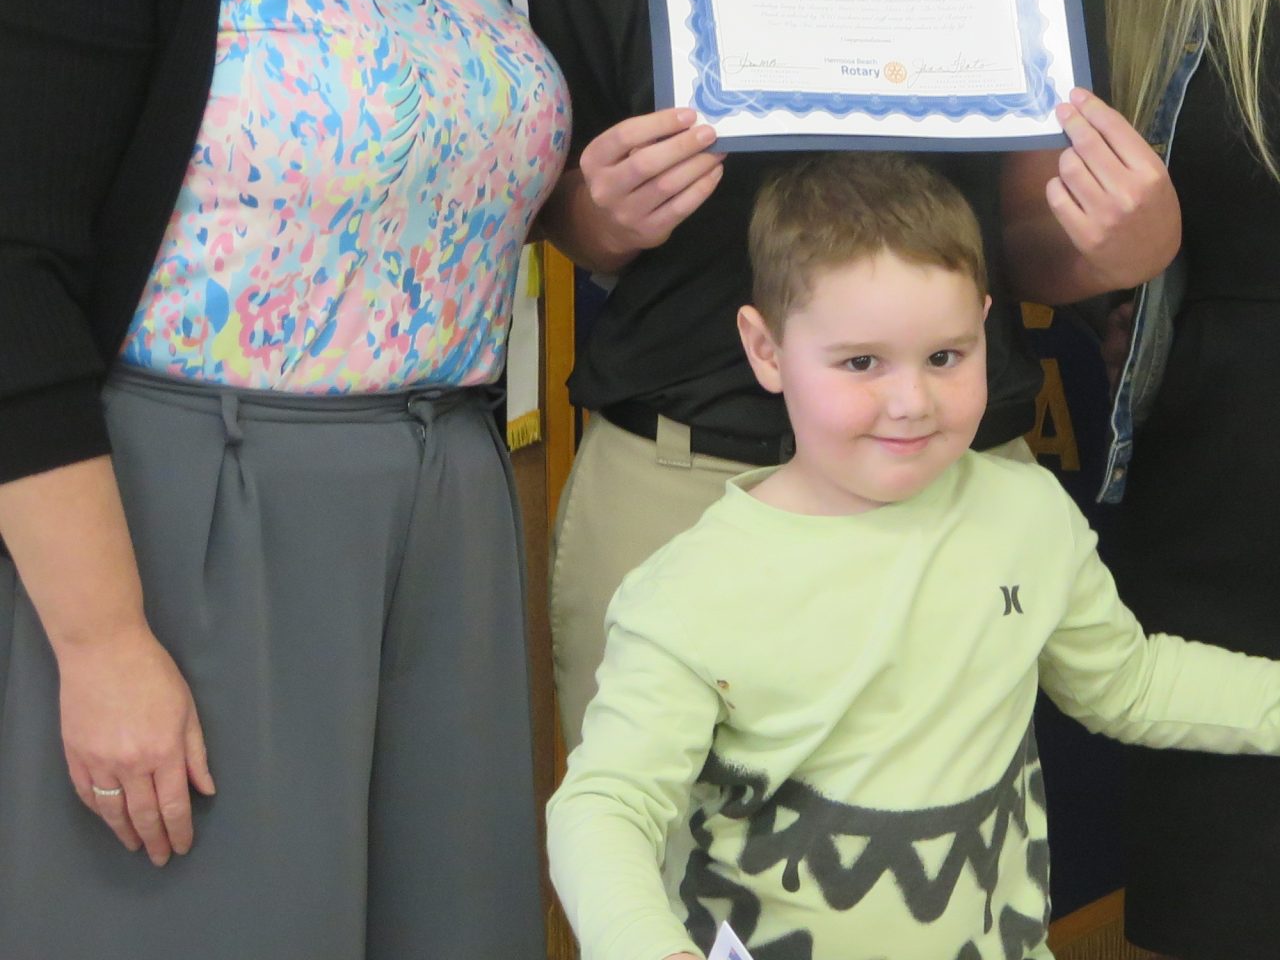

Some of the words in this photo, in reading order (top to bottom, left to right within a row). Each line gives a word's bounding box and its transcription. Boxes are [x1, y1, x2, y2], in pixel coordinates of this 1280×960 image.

[824, 56, 855, 64] Hermosa
[856, 57, 878, 65] Beach
[841, 65, 880, 78] Rotary
